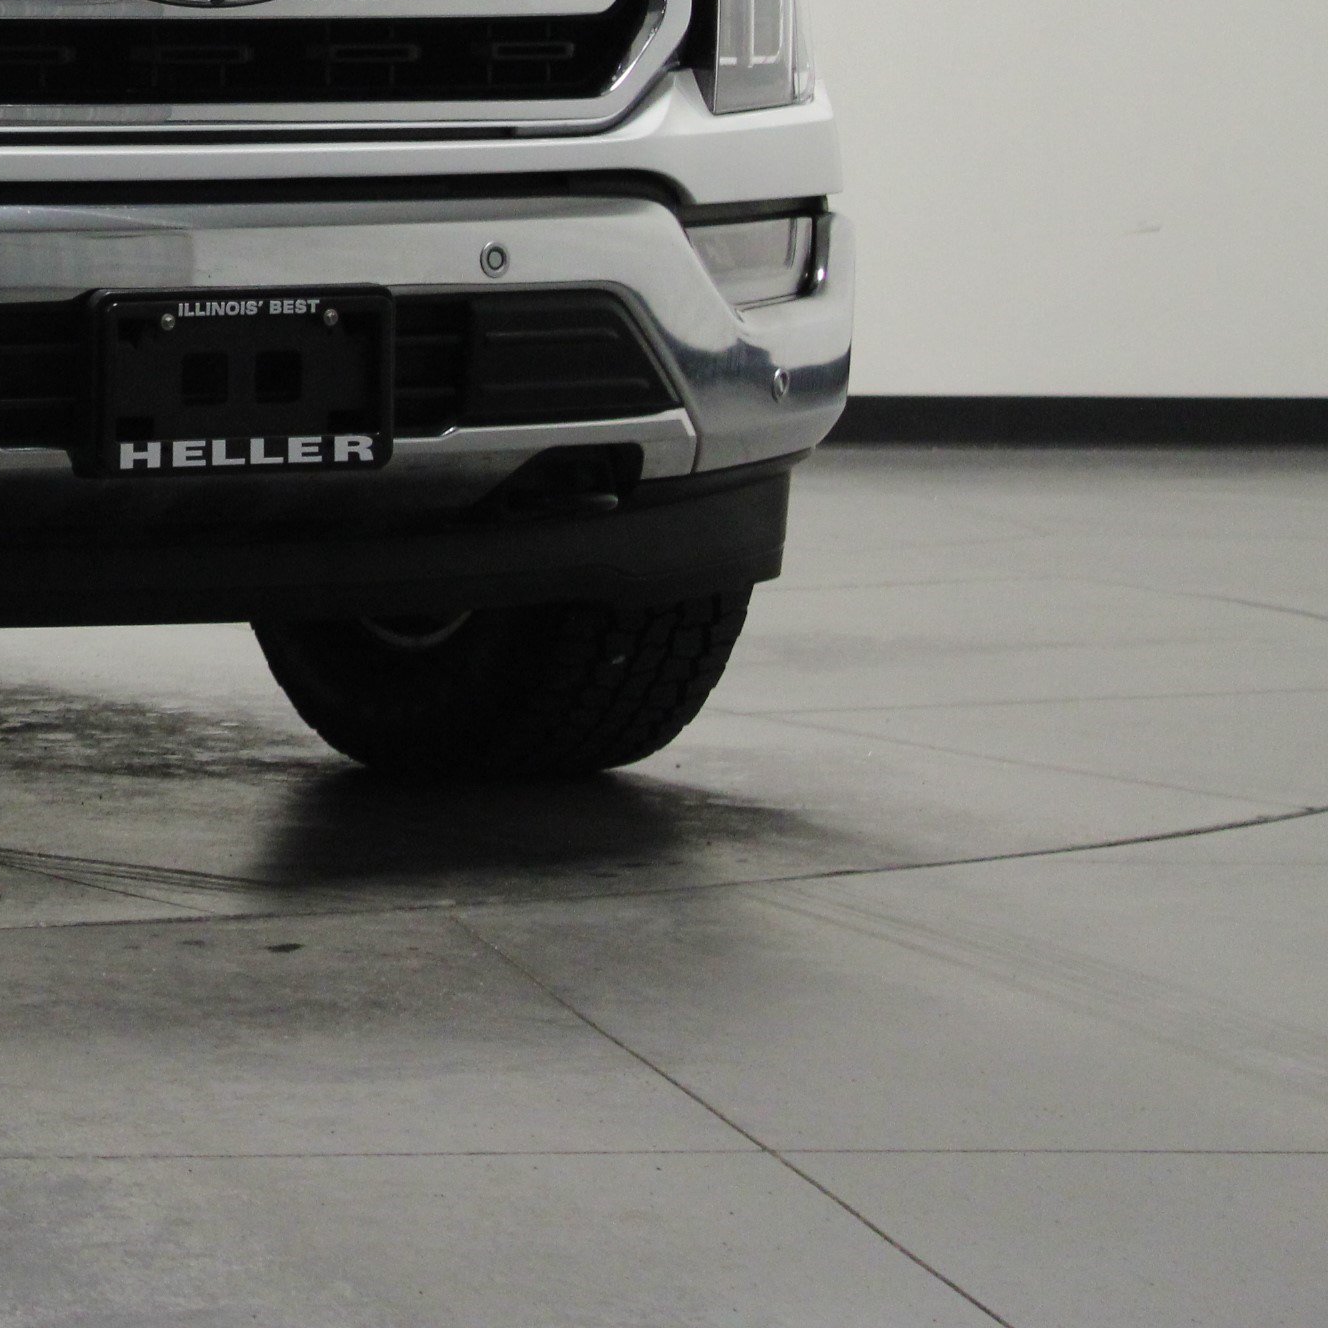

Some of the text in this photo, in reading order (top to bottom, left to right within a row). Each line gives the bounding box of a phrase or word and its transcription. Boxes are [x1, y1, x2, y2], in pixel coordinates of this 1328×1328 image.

[178, 299, 320, 317] ILLINOIS' BEST
[120, 435, 374, 470] HELLER
